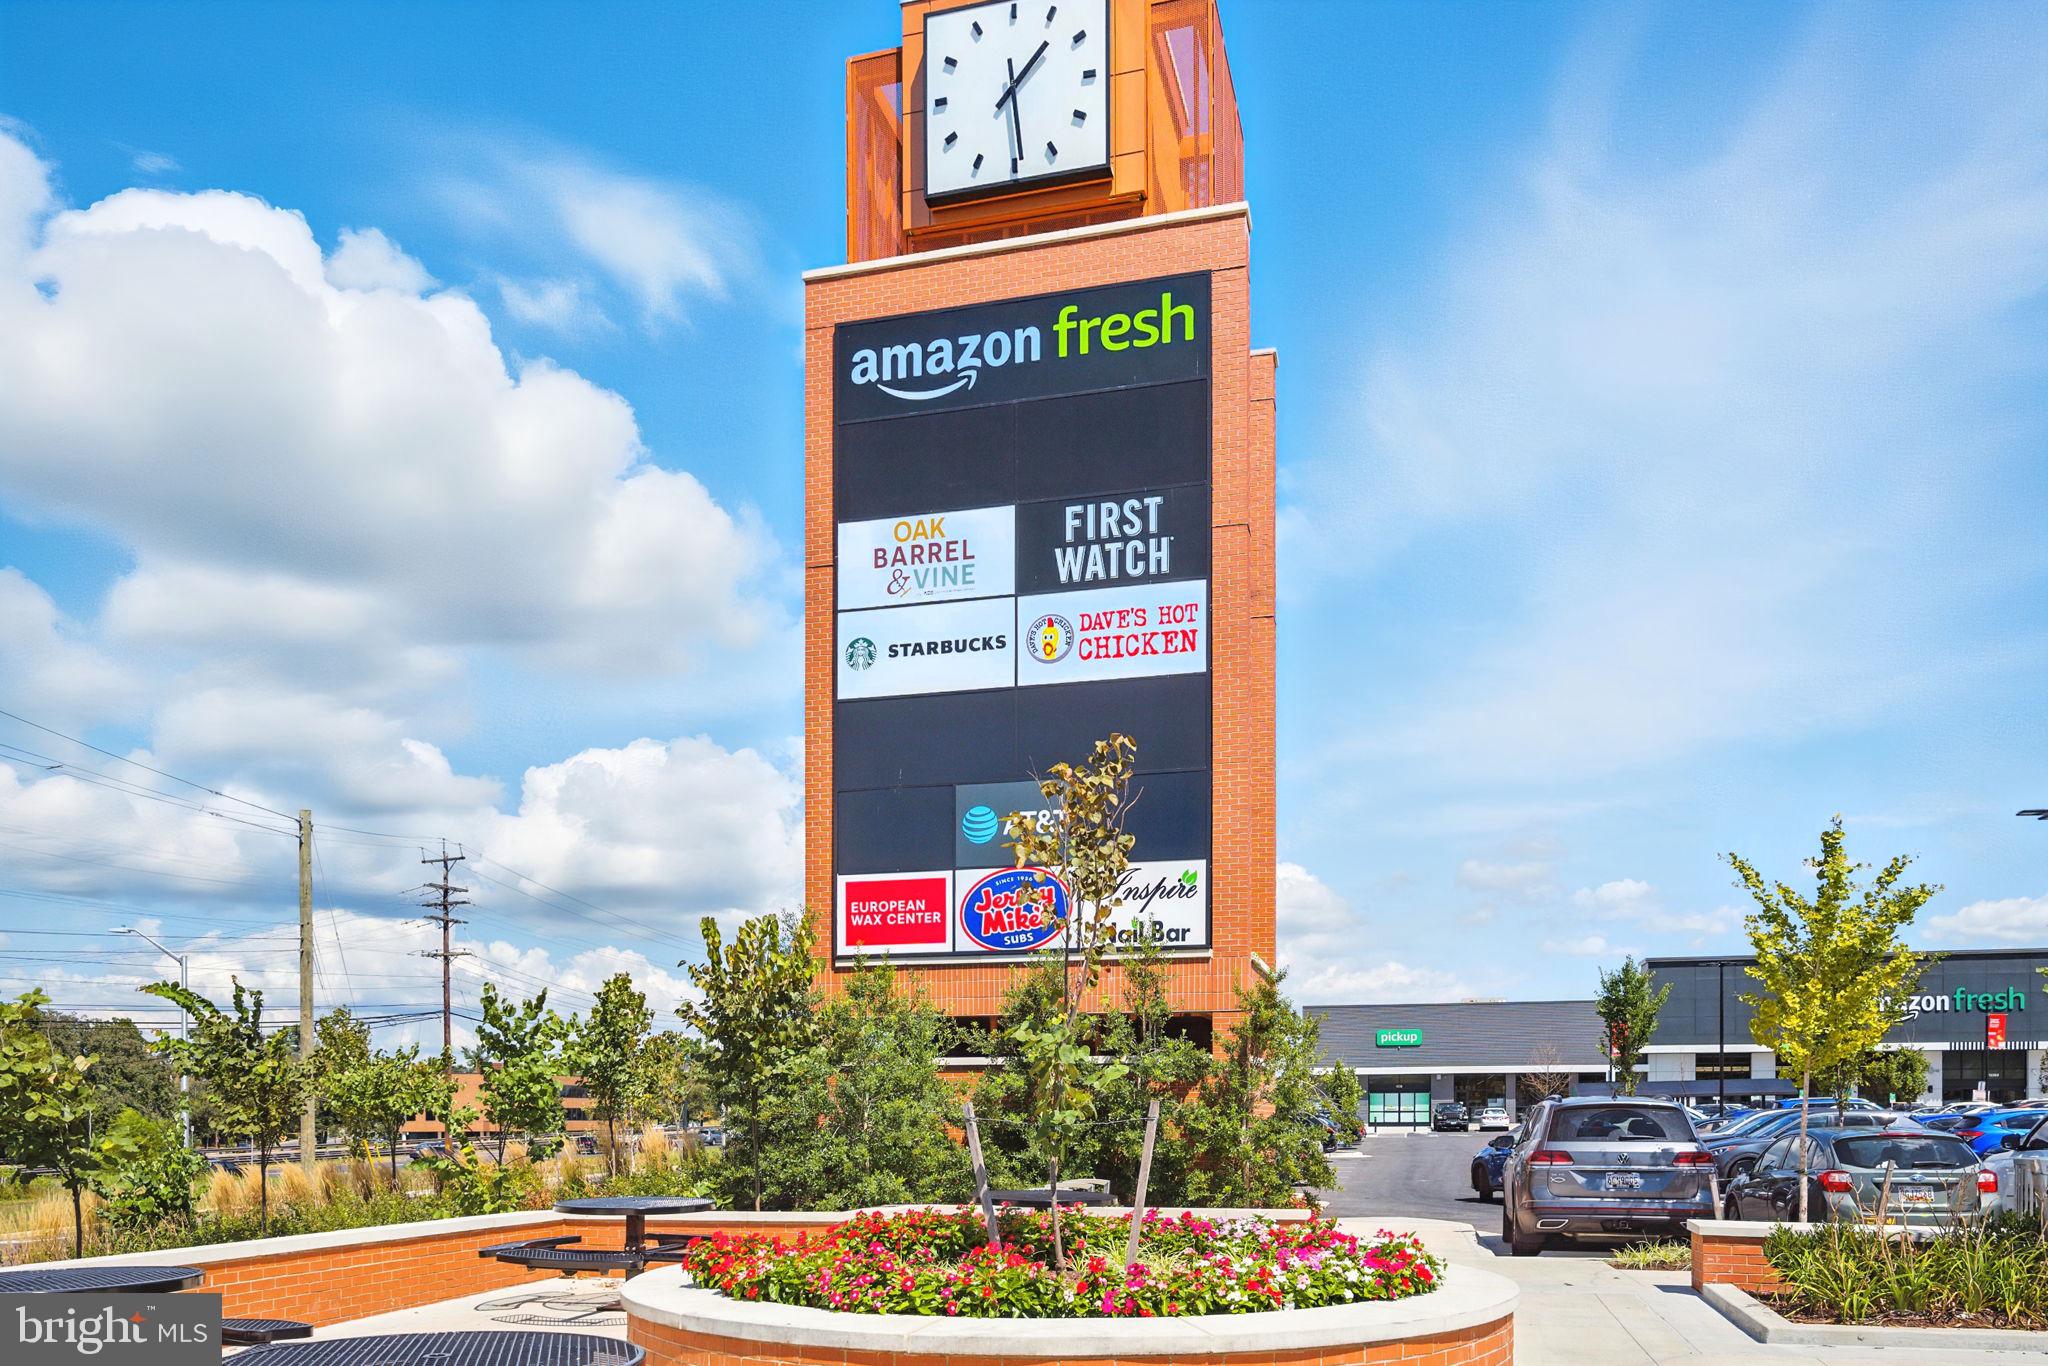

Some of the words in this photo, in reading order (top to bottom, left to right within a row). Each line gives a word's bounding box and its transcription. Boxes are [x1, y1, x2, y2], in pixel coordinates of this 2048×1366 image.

[851, 326, 1041, 386] amazon
[1053, 292, 1194, 358] fresh
[894, 517, 946, 542] OAK
[1065, 496, 1164, 543] FIRST
[874, 539, 976, 569] BARREL
[1054, 536, 1170, 584] WATCH
[887, 568, 911, 597] &
[913, 564, 976, 589] VINE
[1079, 607, 1147, 632] DAVE'S
[1158, 603, 1199, 625] HOT
[888, 634, 1007, 658] STARBUCKS
[1078, 629, 1199, 661] CHICKEN
[995, 877, 1014, 886] SINCE
[1101, 867, 1197, 913] Inspire
[850, 900, 926, 913] EUROPEAN
[975, 886, 1056, 911] Jery
[850, 914, 882, 926] WAX
[886, 912, 941, 925] CENTER
[981, 905, 1050, 936] Mike'
[1152, 920, 1190, 942] Bar
[1004, 933, 1034, 945] SUBS
[1872, 995, 1950, 1012] mazon
[1954, 986, 2025, 1010] fresh
[1380, 1031, 1418, 1044] pickup
